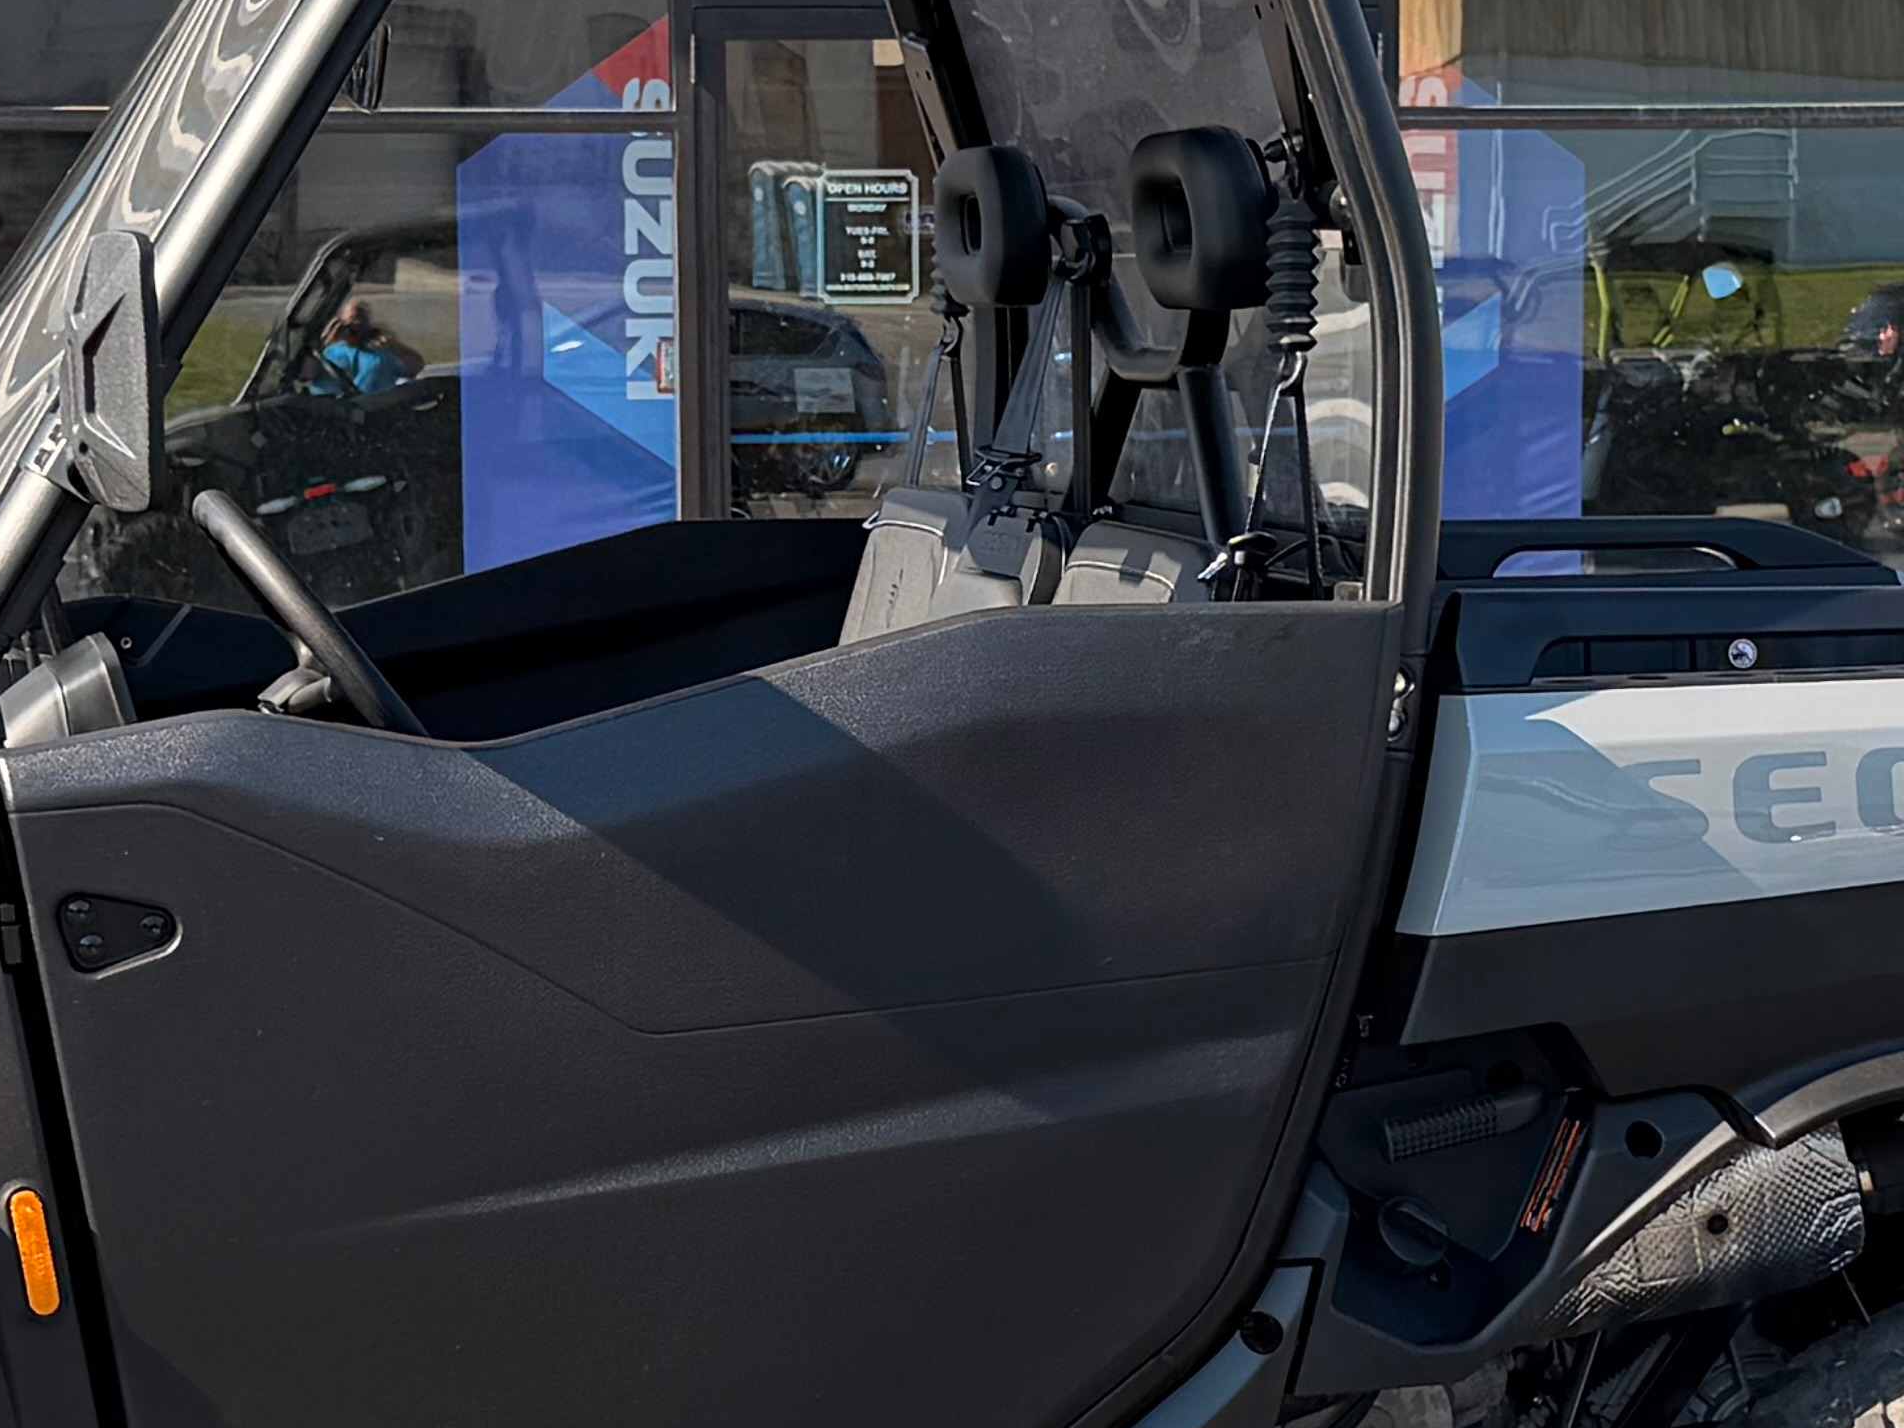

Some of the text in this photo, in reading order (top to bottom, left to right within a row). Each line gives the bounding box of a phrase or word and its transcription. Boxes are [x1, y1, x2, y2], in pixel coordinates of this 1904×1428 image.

[622, 77, 674, 400] SUZUKI
[826, 181, 908, 194] OPEN HOURS
